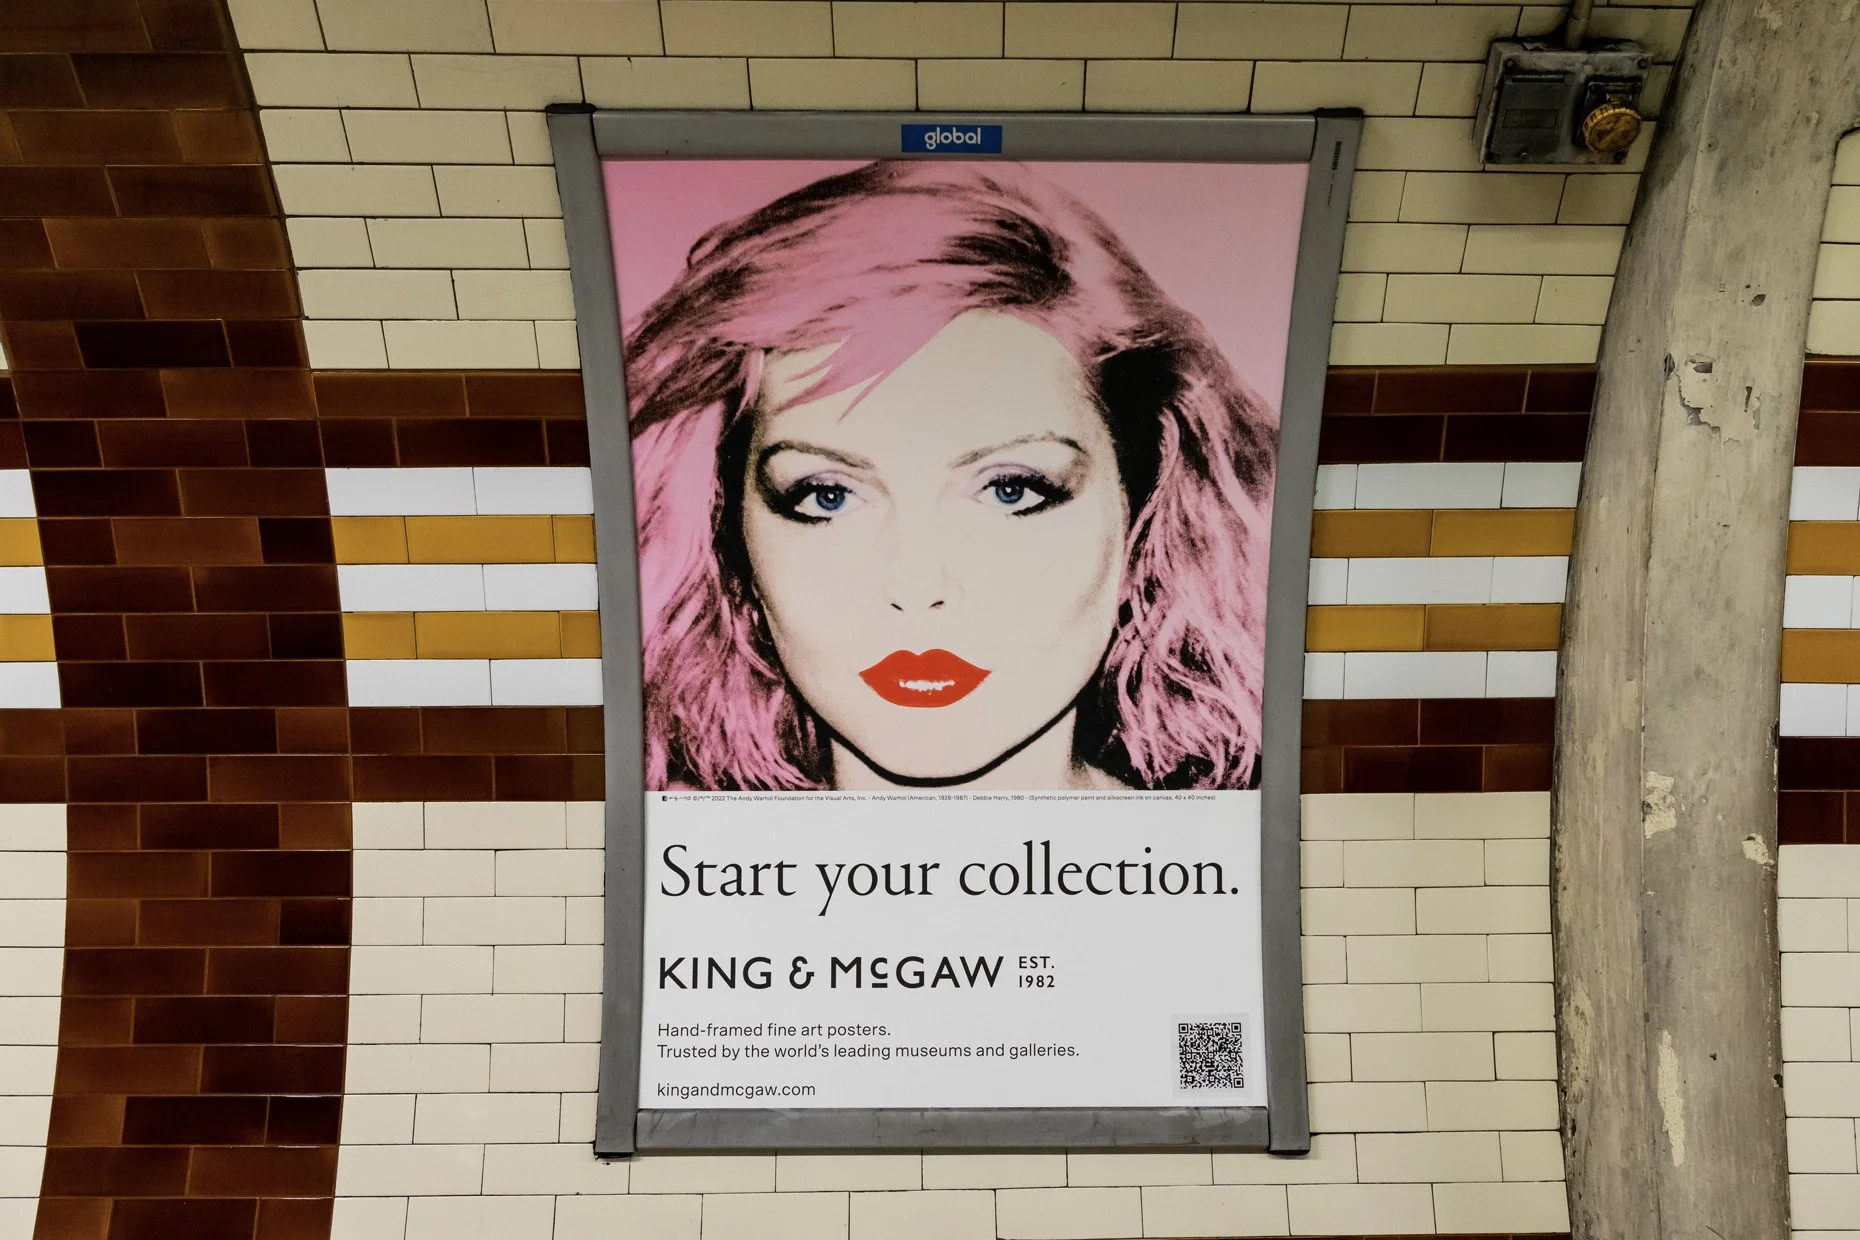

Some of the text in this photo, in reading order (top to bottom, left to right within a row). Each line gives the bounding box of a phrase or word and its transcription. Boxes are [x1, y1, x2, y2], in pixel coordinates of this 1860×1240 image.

[924, 127, 982, 150] global
[660, 839, 1239, 917] Start your collection.
[1018, 955, 1055, 970] EST.
[659, 956, 772, 990] KING
[788, 955, 815, 990] &
[1018, 974, 1056, 989] 1982
[657, 1022, 891, 1041] Hand-framed fine art posters.
[656, 1042, 1080, 1062] Trusted by the world’s leading museums and galleries.
[657, 1082, 816, 1100] kingandmcgaw.com
